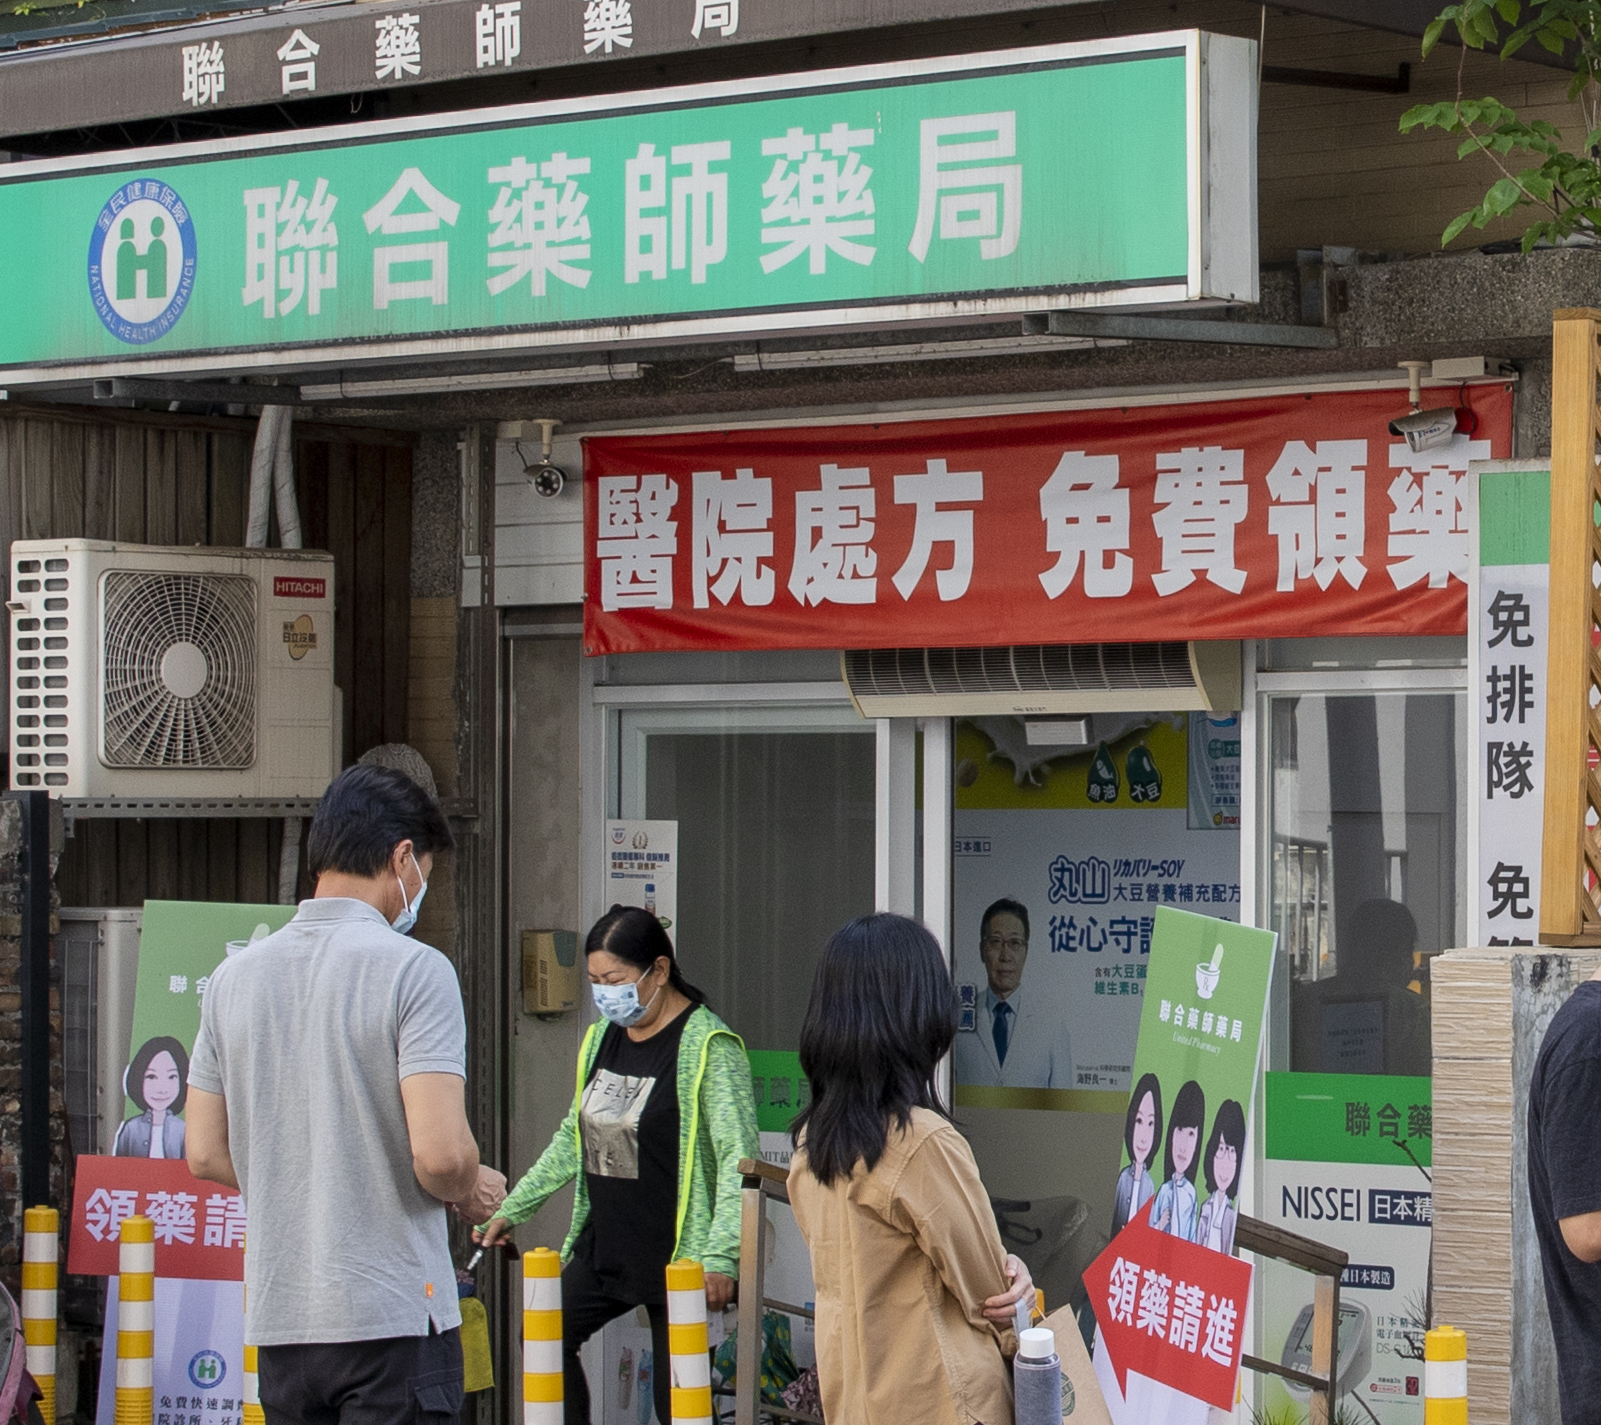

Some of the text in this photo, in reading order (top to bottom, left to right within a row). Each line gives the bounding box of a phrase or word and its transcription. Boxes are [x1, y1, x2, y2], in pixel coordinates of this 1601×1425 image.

[98, 181, 189, 232] 全民健康保險
[242, 110, 1023, 319] 聯合藥師藥局
[91, 258, 194, 340] NATIONAL HEALTH INSURANCE
[597, 433, 1492, 612] 醫院處方 免費領藥
[1130, 782, 1160, 802] 大豆
[1486, 589, 1535, 947] 免排隊 免
[1049, 855, 1110, 904] 丸山
[1113, 883, 1241, 903] 大豆營養補充配方
[1159, 999, 1243, 1043] 聯合藥師藥局
[1282, 1185, 1360, 1222] NISSEI
[1106, 1256, 1238, 1368] 領藥請進
